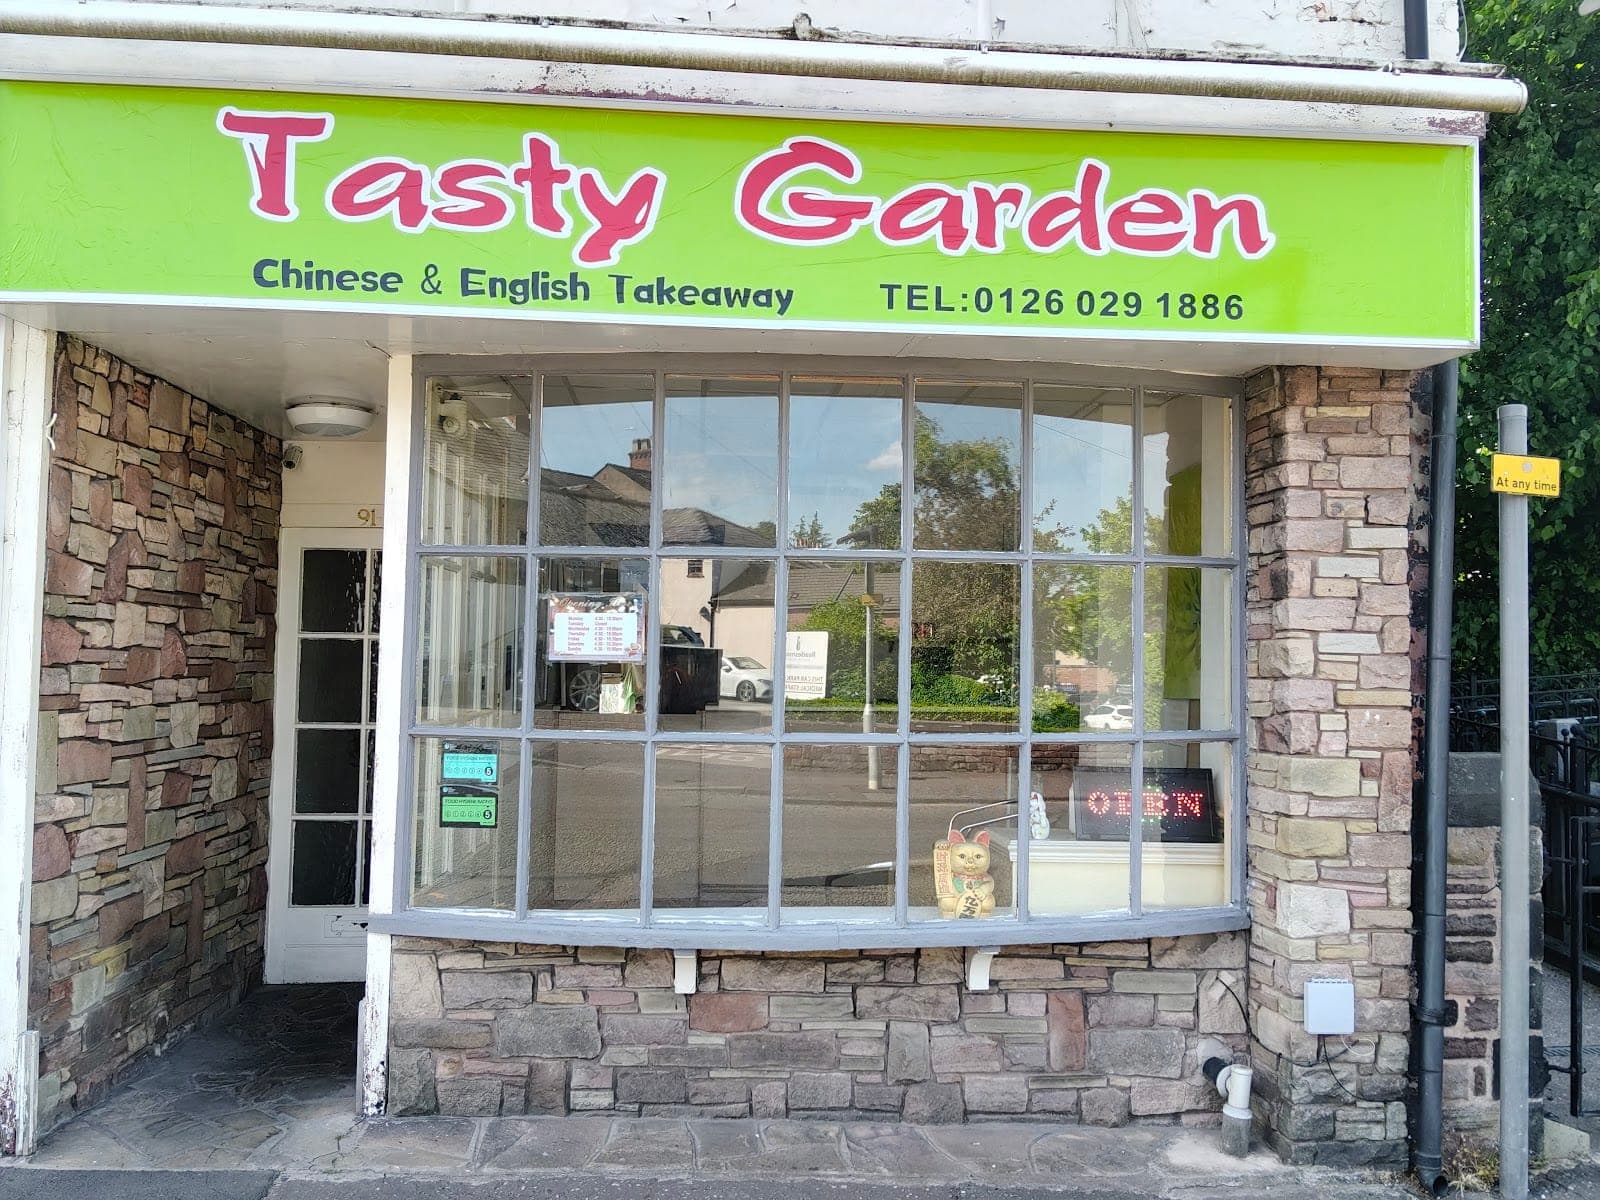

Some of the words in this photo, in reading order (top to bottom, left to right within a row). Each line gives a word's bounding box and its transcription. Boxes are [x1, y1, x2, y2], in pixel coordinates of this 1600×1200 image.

[219, 109, 663, 265] Tasty
[738, 139, 1272, 257] Garden
[253, 258, 402, 293] Chinese
[420, 264, 442, 295] &
[460, 267, 590, 304] English
[608, 273, 794, 316] Takeaway
[880, 284, 1064, 315] TEL:0126
[1077, 290, 1142, 318] 029
[1157, 293, 1244, 320] 1886
[1496, 476, 1509, 487] At
[1512, 480, 1530, 490] any
[1534, 480, 1557, 491] time
[357, 509, 376, 526] 91
